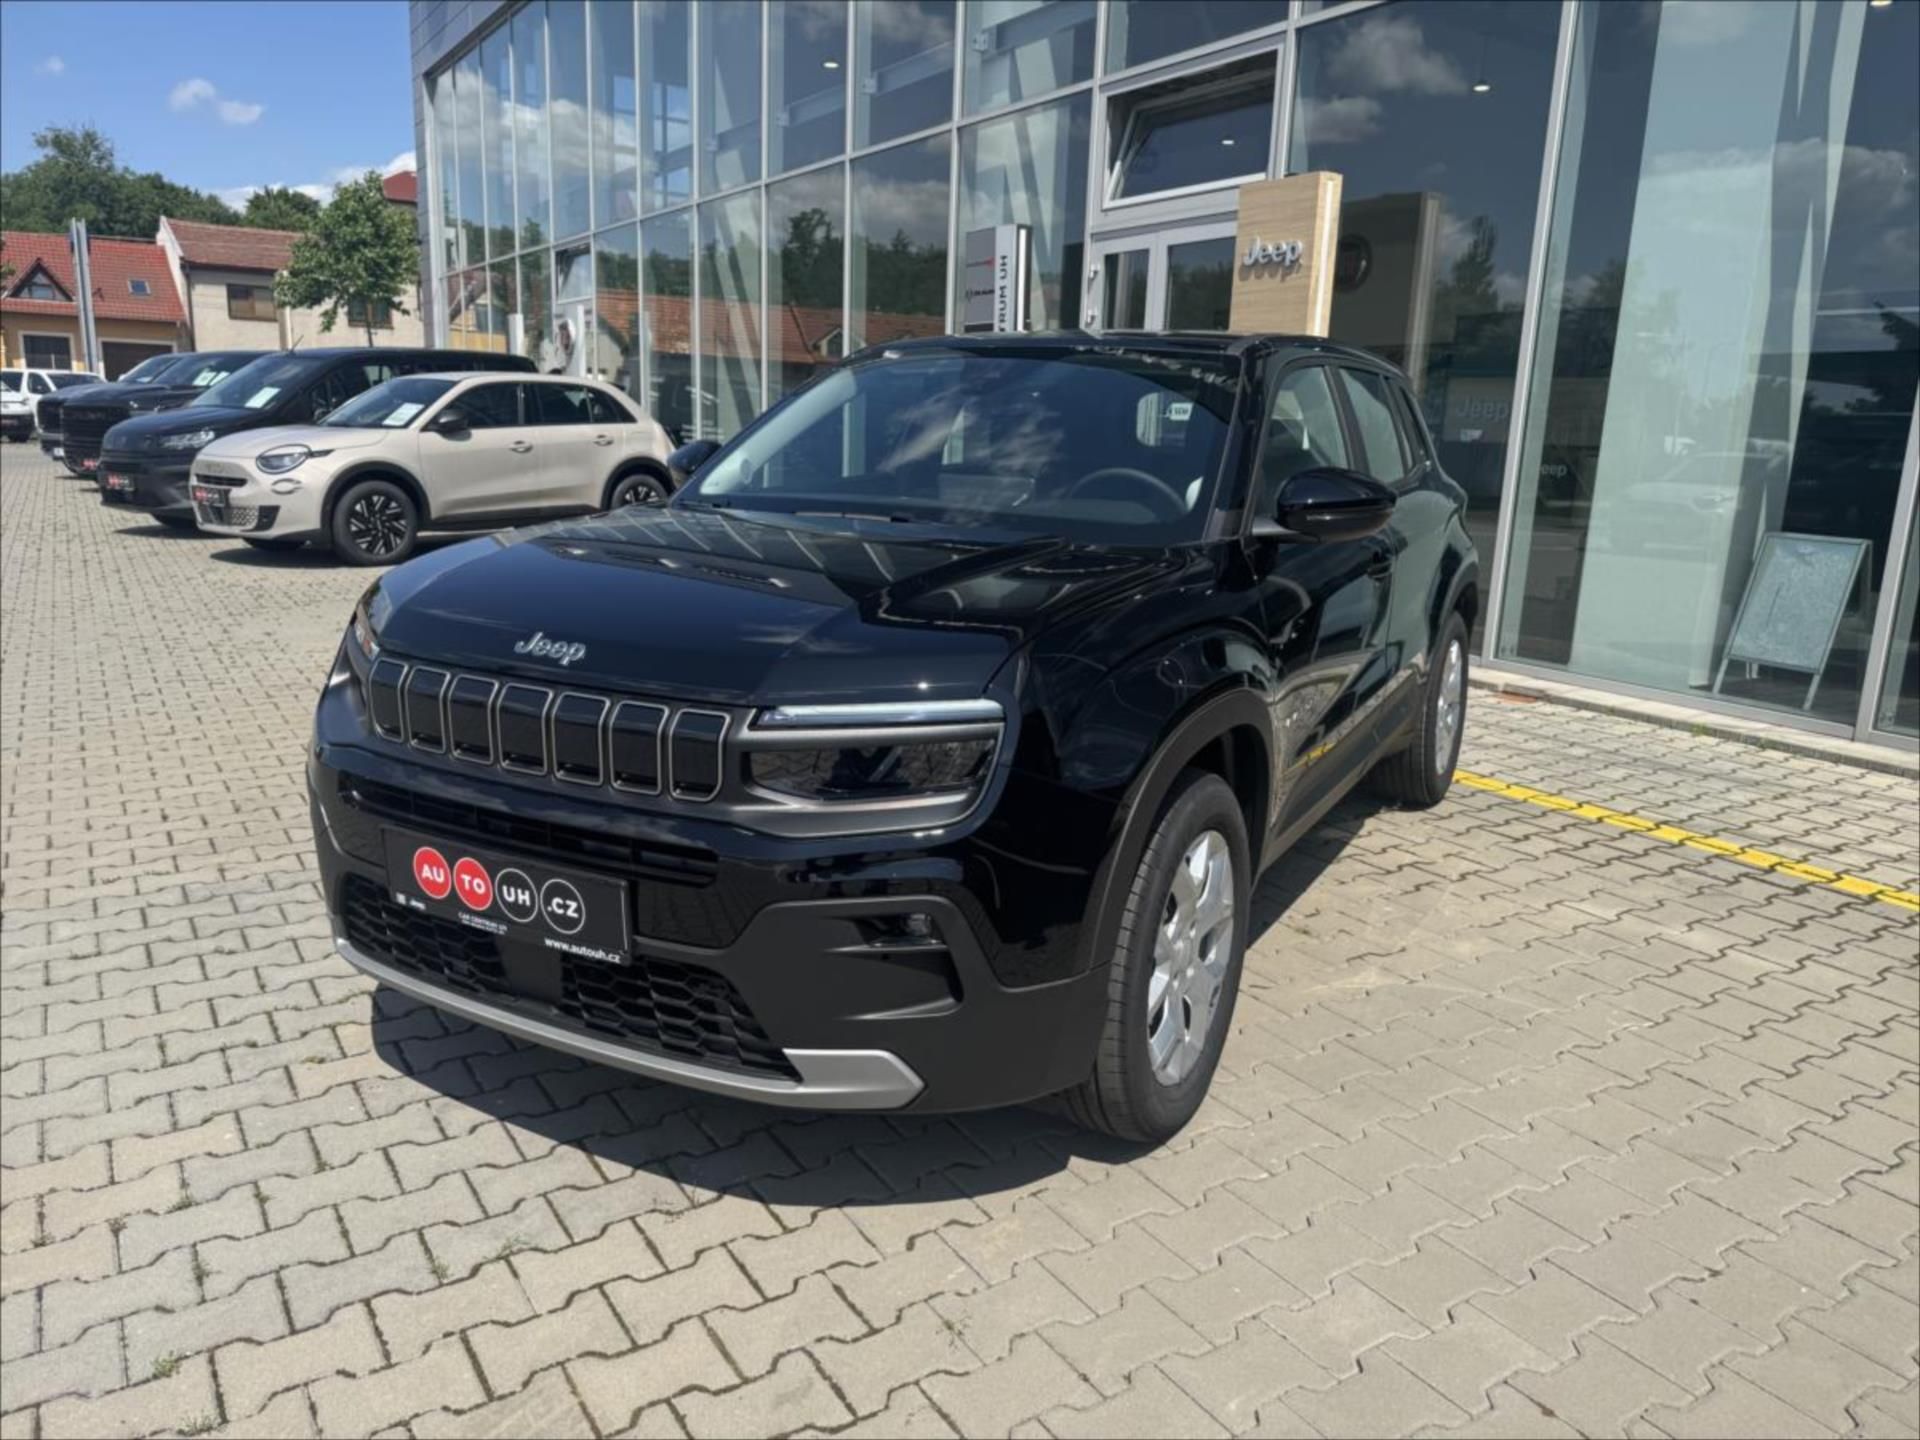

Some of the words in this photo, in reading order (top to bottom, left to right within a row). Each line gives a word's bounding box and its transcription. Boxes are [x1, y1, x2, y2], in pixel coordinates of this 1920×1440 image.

[1243, 235, 1303, 267] Jeep
[1456, 396, 1509, 422] Jeep
[1538, 463, 1569, 479] eep
[513, 631, 586, 667] Jeep
[502, 885, 531, 907] UH
[544, 937, 621, 965] www.autouh.cz
